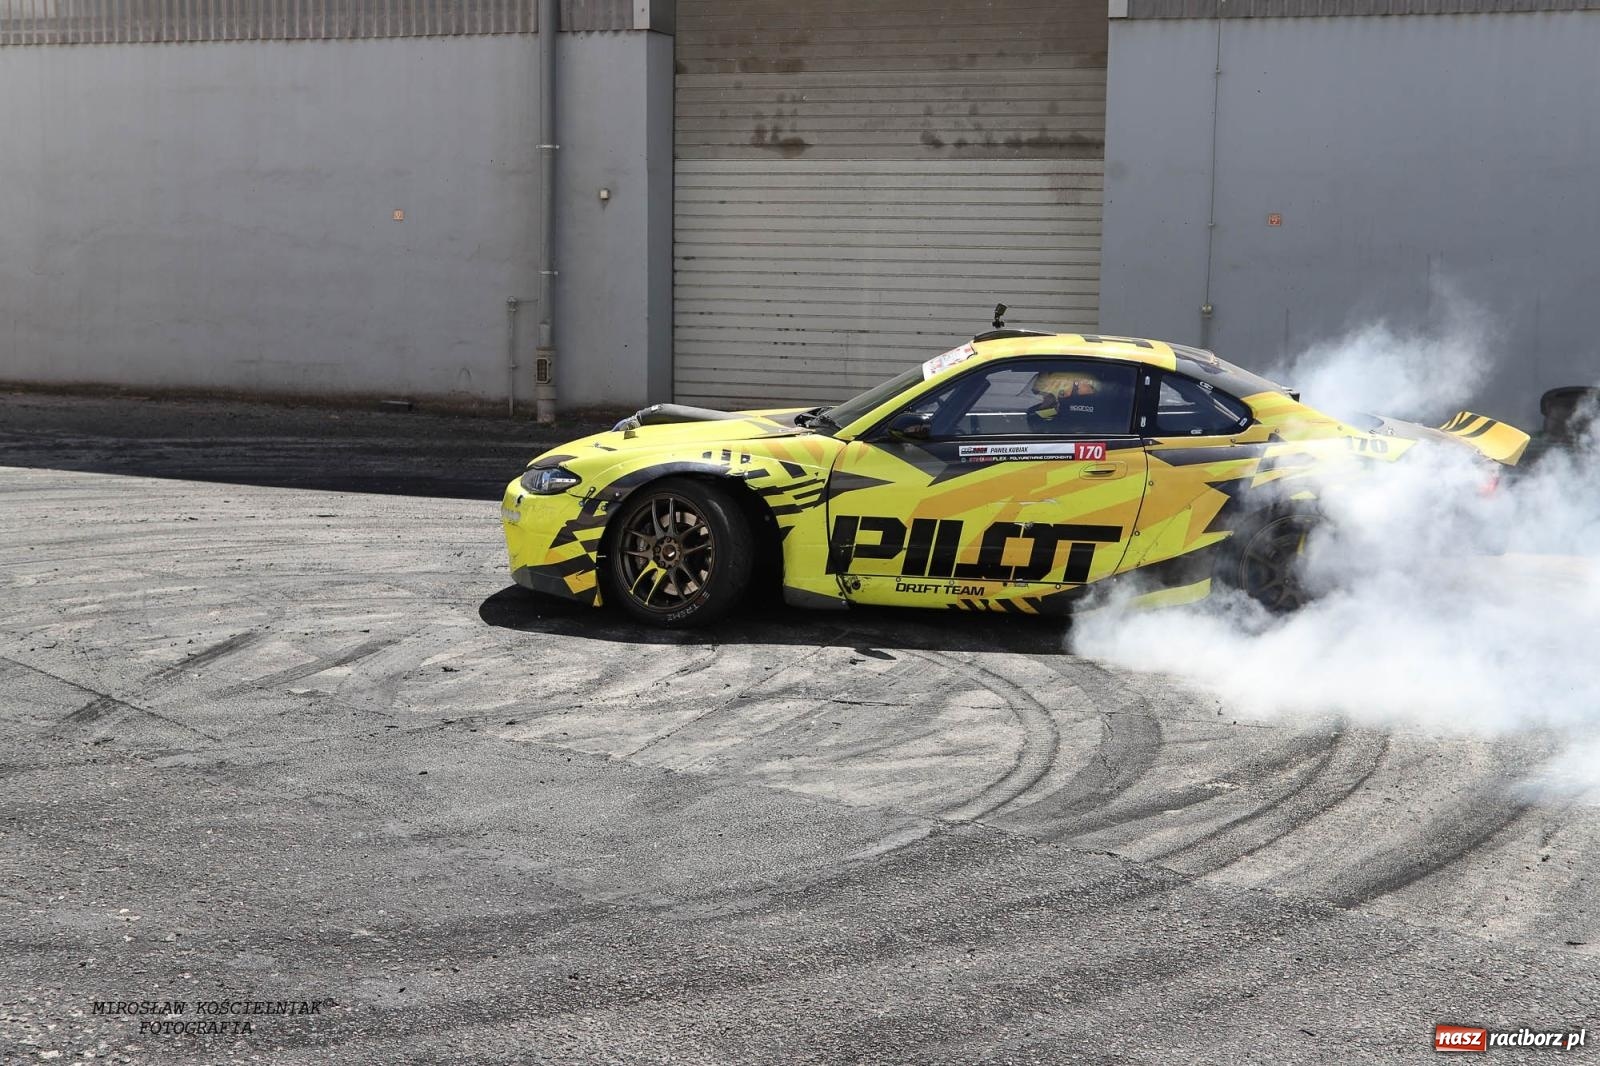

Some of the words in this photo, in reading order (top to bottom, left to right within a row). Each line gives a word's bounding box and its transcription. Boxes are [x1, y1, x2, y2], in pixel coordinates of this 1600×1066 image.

[1078, 445, 1103, 459] 170
[825, 515, 1123, 583] PILOT
[895, 582, 942, 594] DRIFT
[943, 585, 985, 596] TEAM
